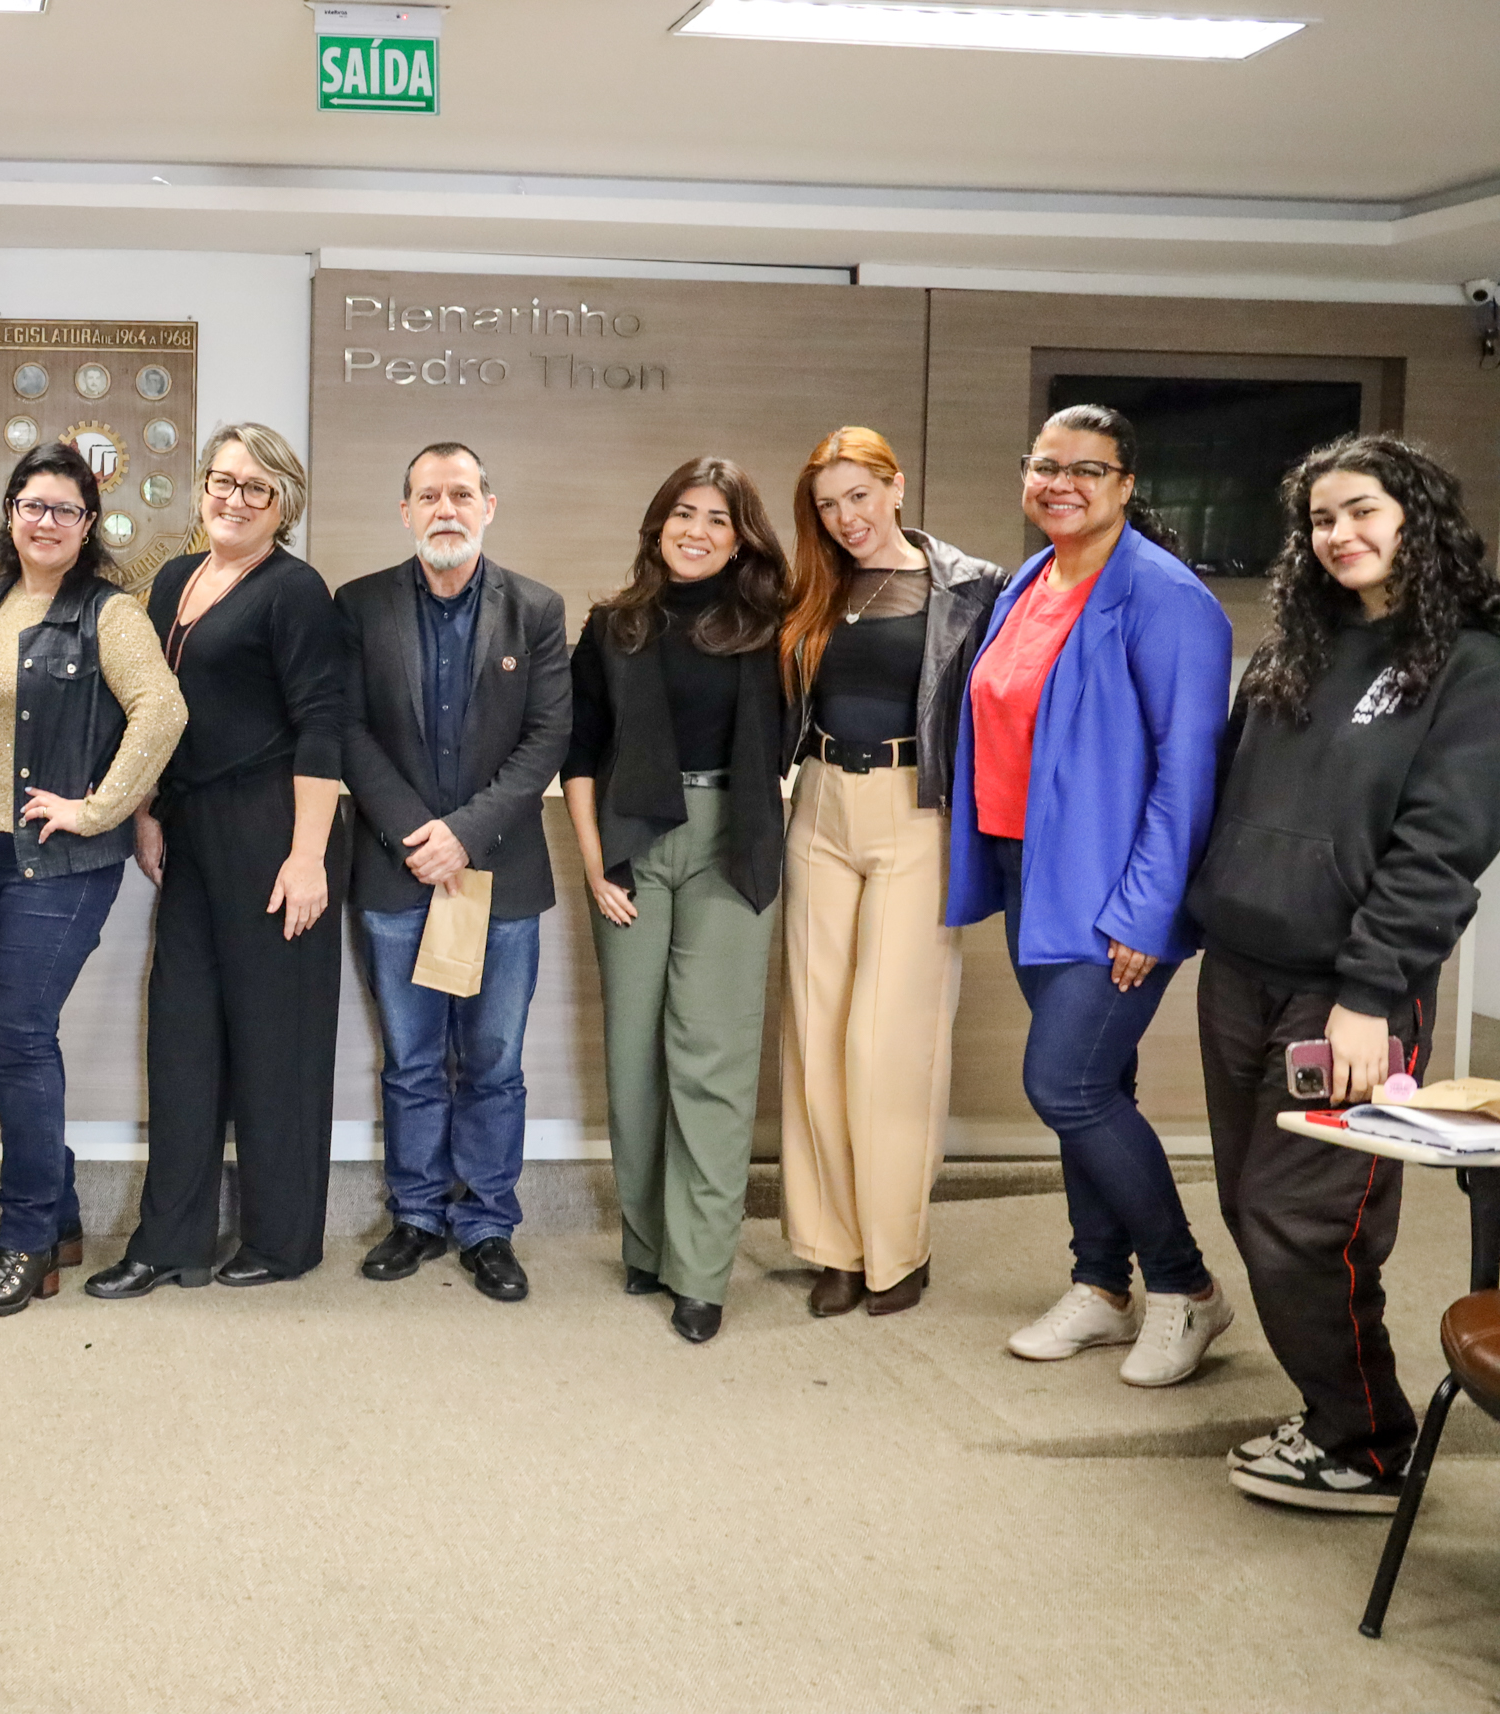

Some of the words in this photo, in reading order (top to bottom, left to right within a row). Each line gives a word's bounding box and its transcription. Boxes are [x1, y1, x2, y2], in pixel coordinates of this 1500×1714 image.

[322, 38, 433, 97] SAÍDA
[115, 329, 146, 345] 1964
[159, 330, 191, 346] 1968
[345, 295, 641, 338] Plenarinho
[344, 347, 510, 386] Pedro
[529, 351, 667, 391] Thon
